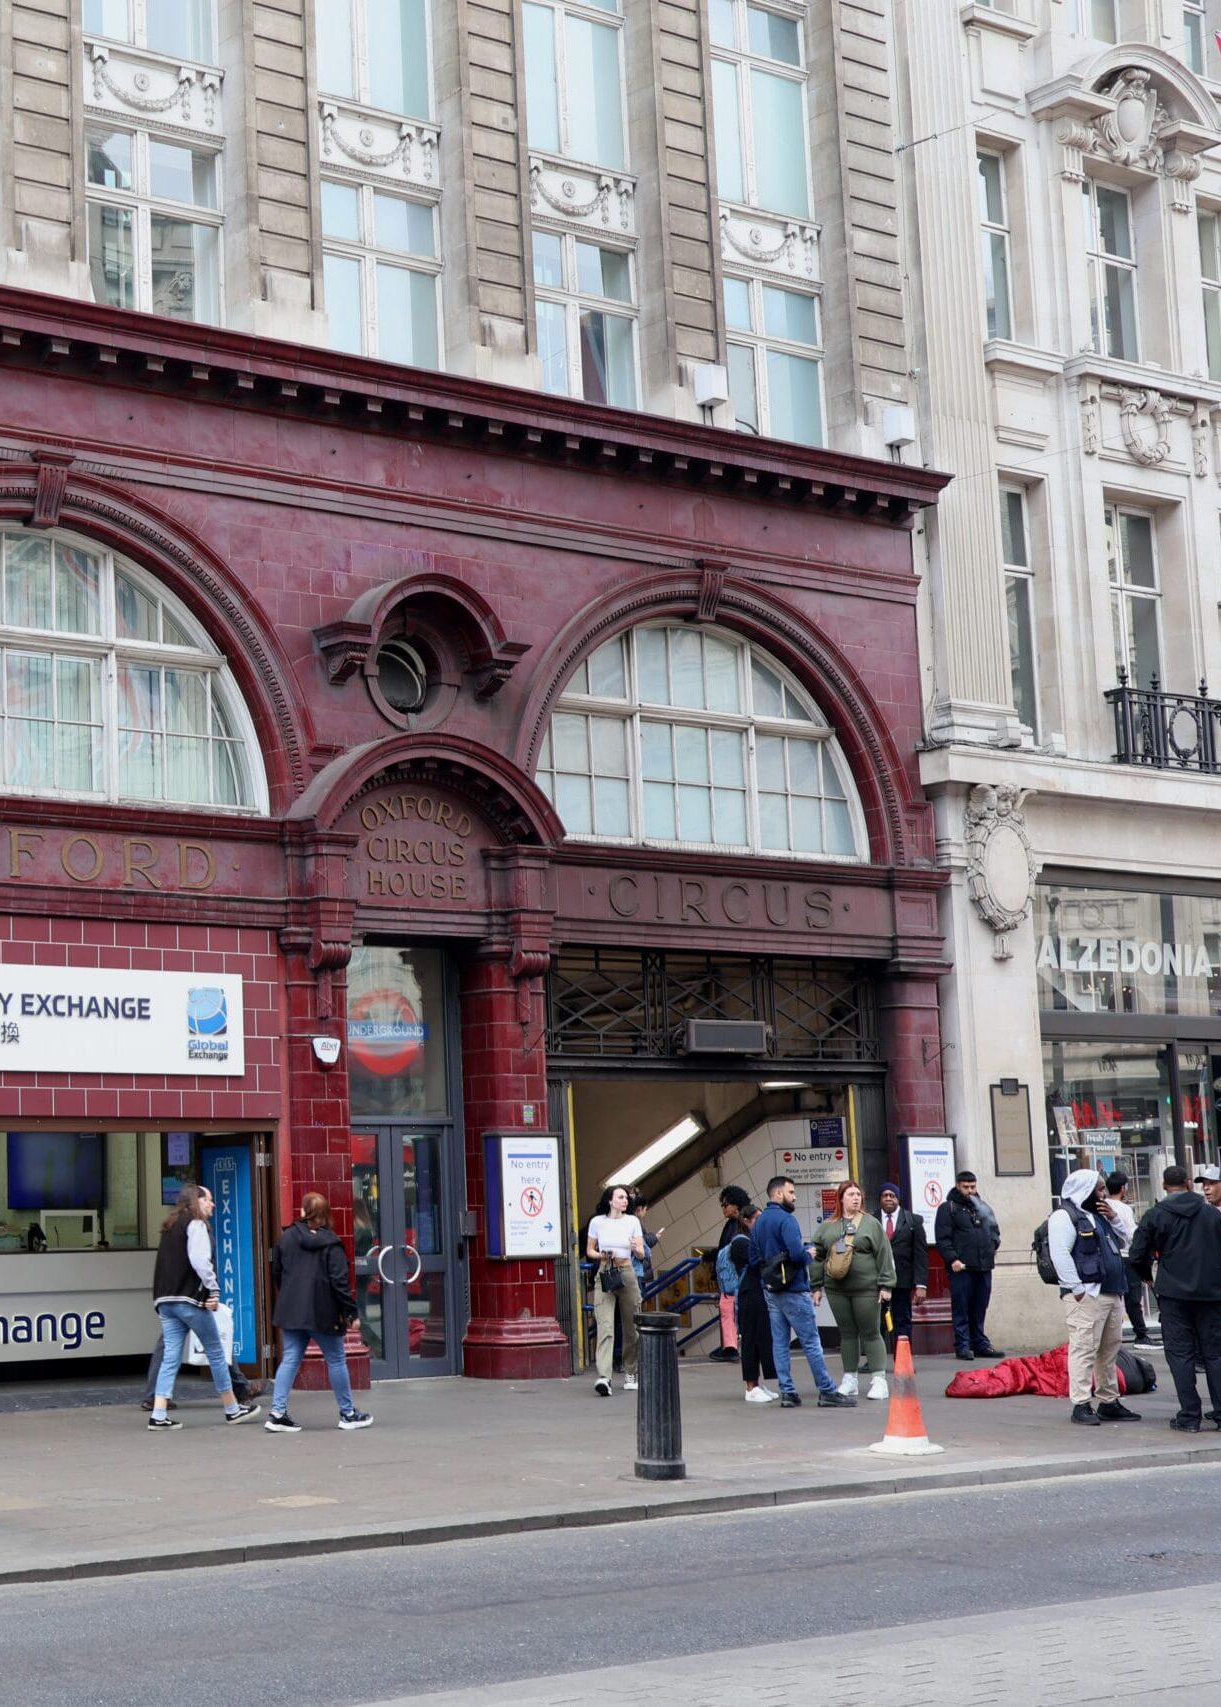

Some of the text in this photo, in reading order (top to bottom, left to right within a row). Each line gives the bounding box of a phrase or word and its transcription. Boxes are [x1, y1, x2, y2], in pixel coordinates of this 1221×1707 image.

[361, 795, 472, 838] OXFORD
[367, 838, 466, 867] CIRCUS
[367, 870, 467, 900] HOUSE
[609, 874, 833, 928] CIRCUS
[21, 993, 151, 1020] EXCHANGE
[188, 1039, 229, 1050] Global
[188, 1050, 229, 1061] Exchange
[794, 1152, 832, 1162] No entry
[928, 1157, 947, 1166] entry
[511, 1160, 550, 1171] No entry
[521, 1176, 541, 1184] here
